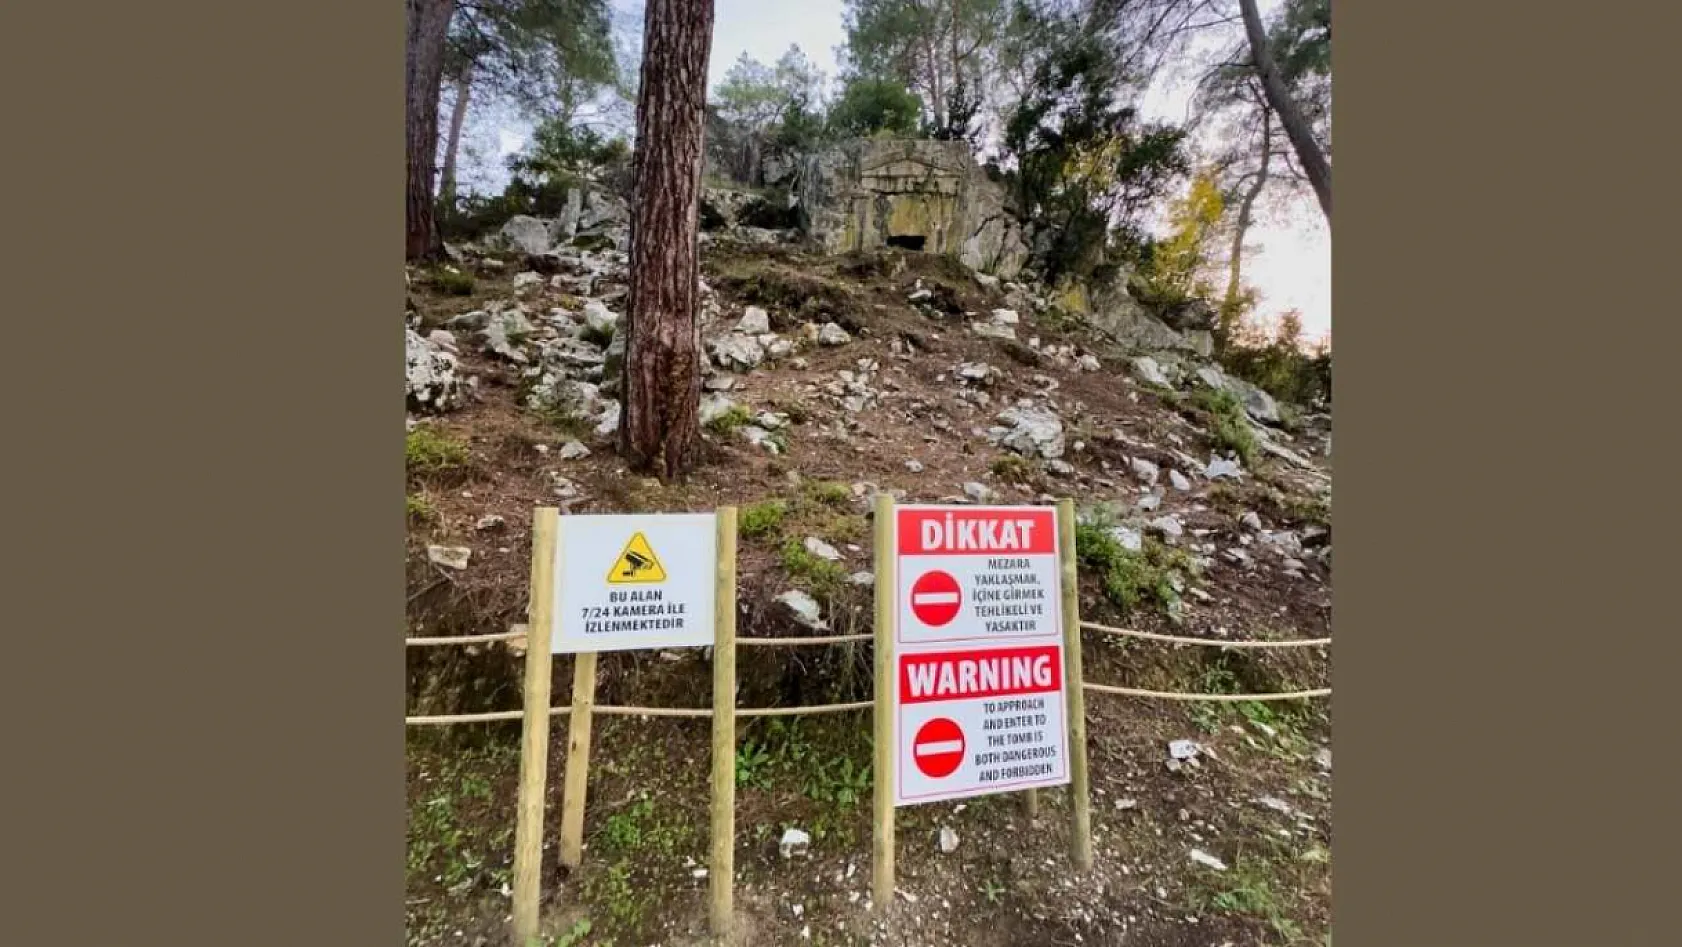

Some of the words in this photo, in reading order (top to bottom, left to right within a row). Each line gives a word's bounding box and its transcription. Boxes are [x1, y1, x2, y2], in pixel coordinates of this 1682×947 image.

[921, 511, 1035, 550] DİKKAT
[988, 558, 1031, 569] MEZARA
[609, 591, 627, 603] BU
[630, 589, 663, 602] ALAN
[1003, 585, 1044, 601] GİRMEK
[582, 606, 610, 619] 7/24
[613, 604, 664, 617] KAMERA
[667, 602, 685, 615] İLE
[975, 603, 1028, 617] TEHLİKELİ
[1030, 603, 1043, 615] VE
[585, 617, 684, 633] İZLENMEKTEDİR
[985, 620, 1036, 632] YASAKTIR
[907, 654, 1052, 698] WARNING
[984, 702, 995, 714] TO
[997, 698, 1045, 712] APPROACH
[983, 718, 1003, 730] AND
[1005, 716, 1033, 728] ENTER
[1035, 714, 1047, 726] TO
[988, 735, 1004, 747] THE
[1007, 732, 1032, 745] TOMB
[1034, 731, 1044, 742] IS
[975, 752, 1001, 766] BOTH
[1002, 746, 1057, 763] DANGEROUS
[979, 769, 999, 782] AND
[1001, 763, 1052, 779] FORBIDDEN
